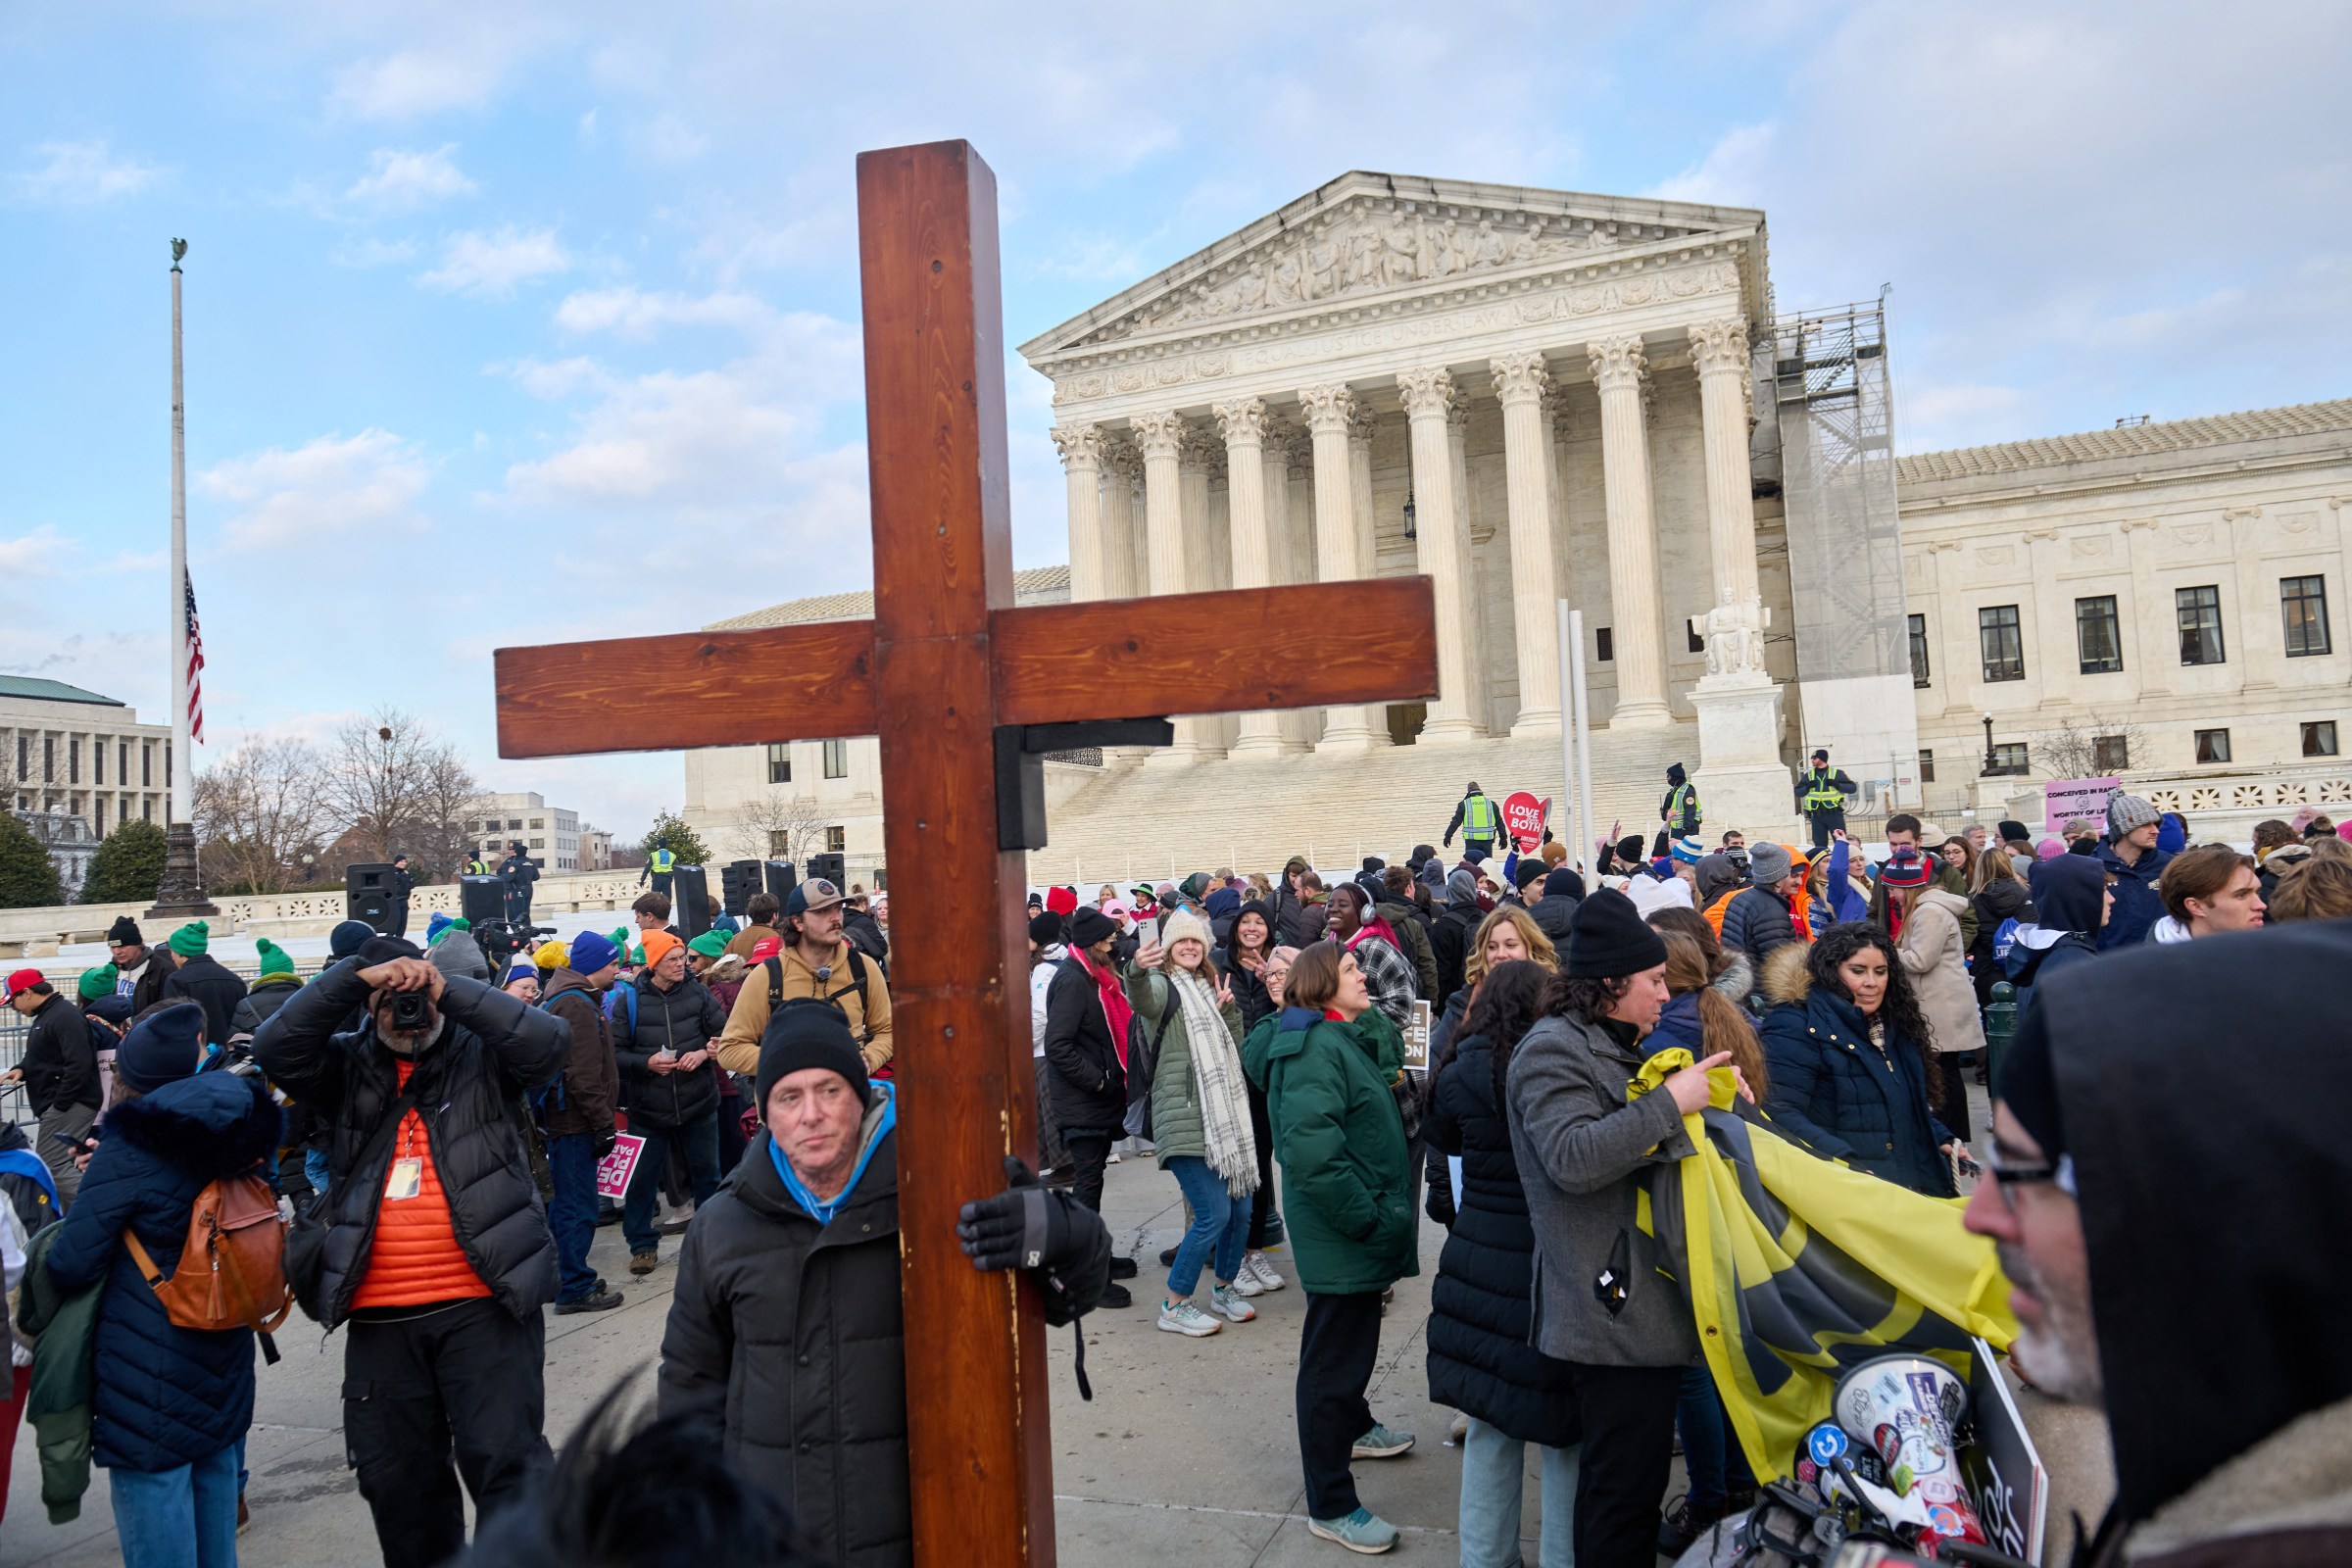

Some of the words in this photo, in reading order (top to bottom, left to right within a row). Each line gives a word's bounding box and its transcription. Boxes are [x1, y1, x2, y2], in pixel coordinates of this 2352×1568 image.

[1246, 344, 1307, 367] EQUAL
[1313, 330, 1382, 355] JUSTICE
[1392, 318, 1458, 341] UNDER
[1463, 312, 1501, 330] LAW
[2047, 789, 2088, 798] CONCEIVED
[1509, 804, 1540, 819] LOVE
[1511, 817, 1541, 832] BOTH
[1995, 949, 2010, 957] LIF
[597, 1166, 626, 1186] DE
[1916, 1439, 1925, 1471] PRO-LIFE
